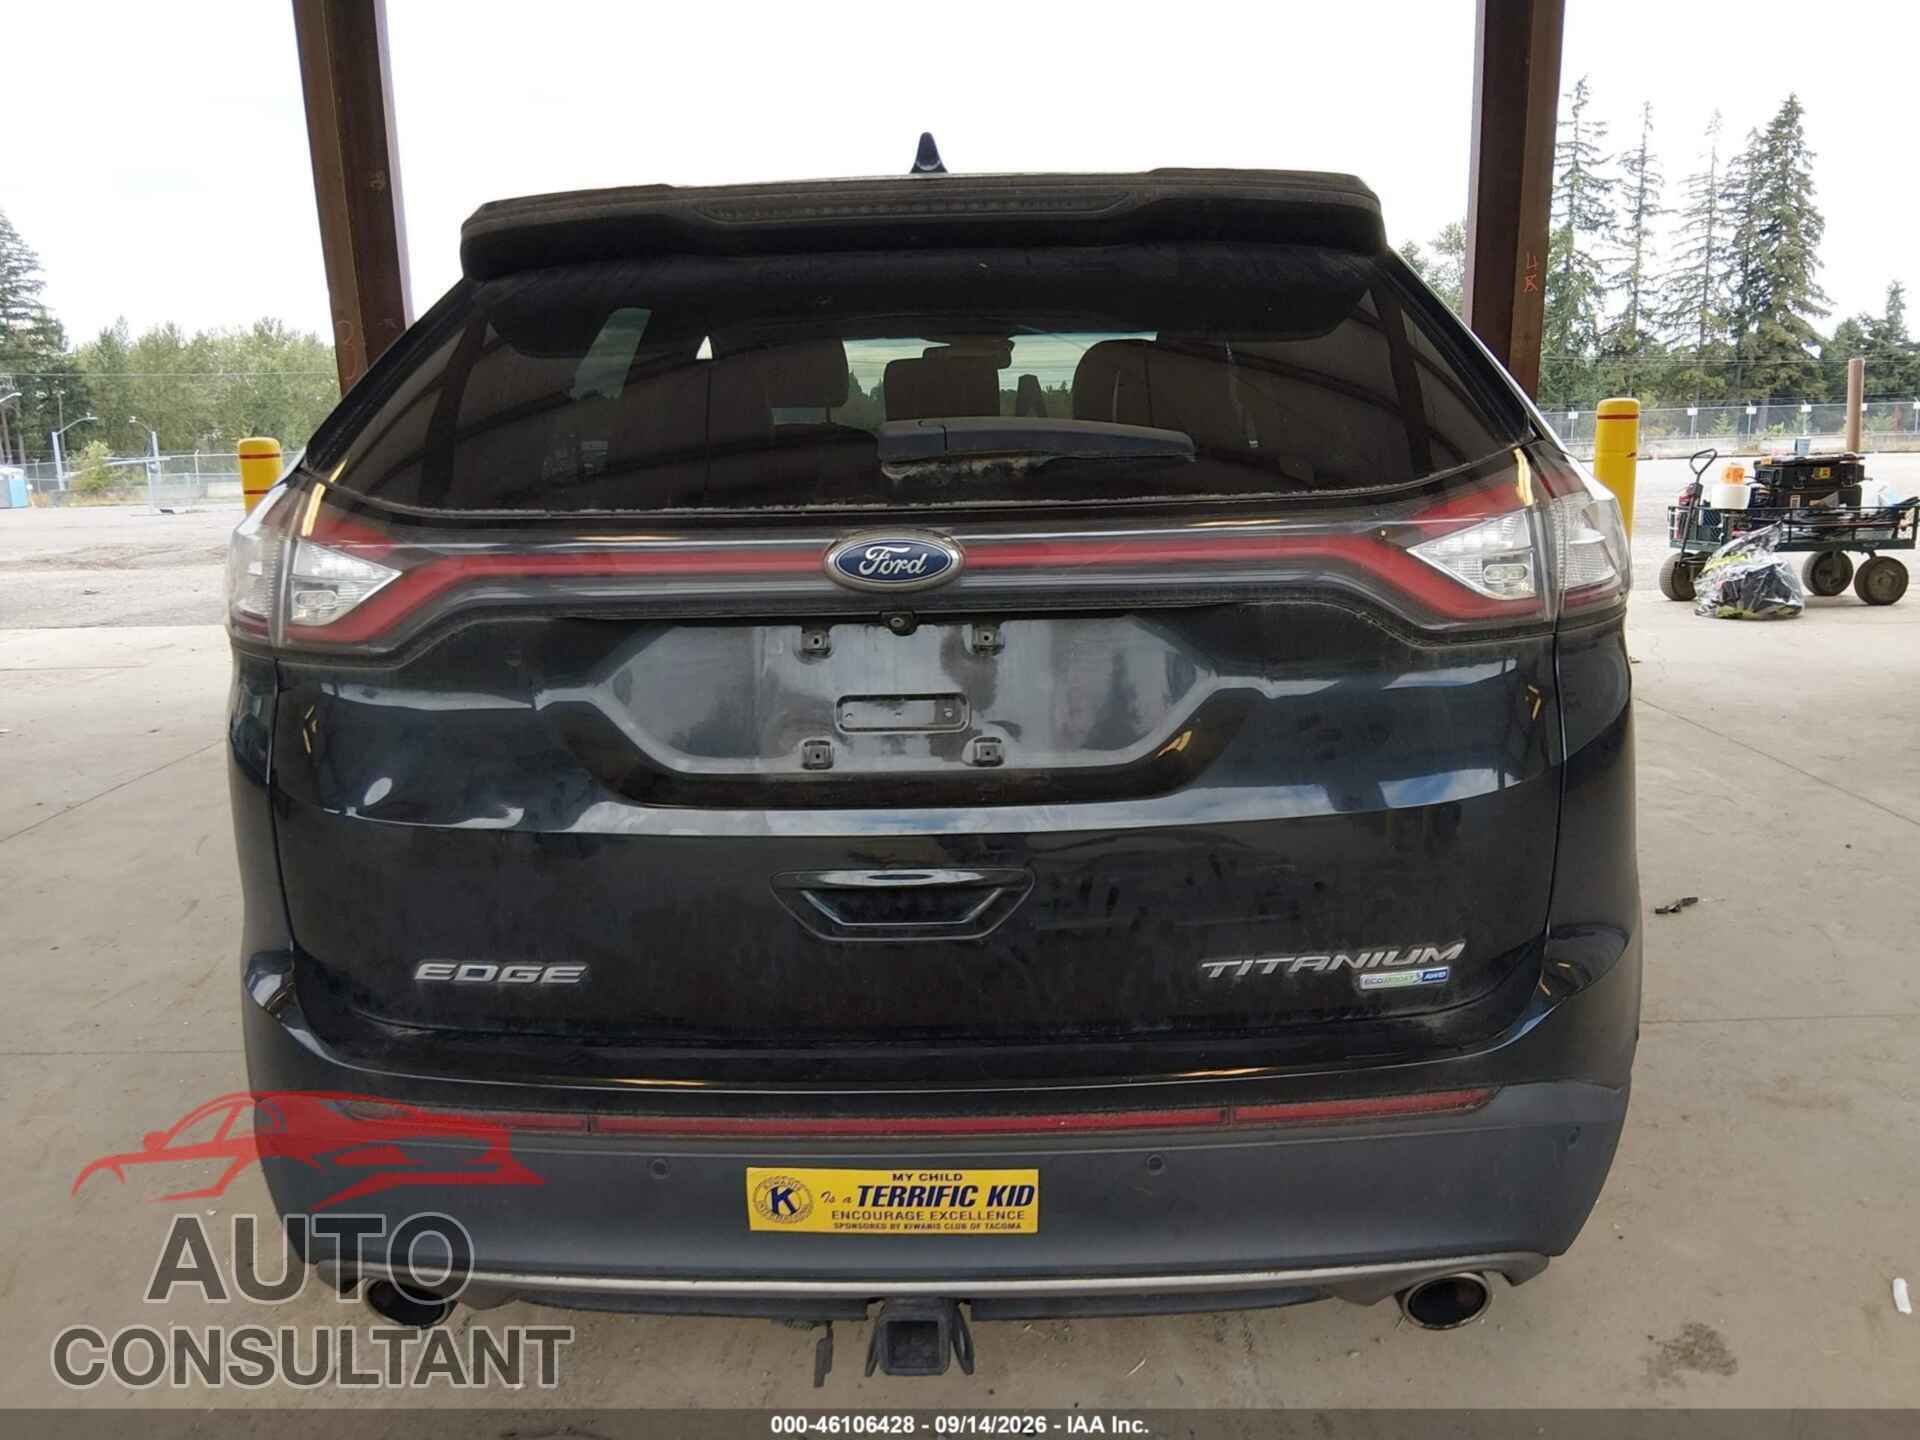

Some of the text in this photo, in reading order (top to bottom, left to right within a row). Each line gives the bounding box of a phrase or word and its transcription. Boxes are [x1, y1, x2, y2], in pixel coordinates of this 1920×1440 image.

[859, 546, 928, 575] Ford
[1201, 941, 1466, 978] TITANIUM
[415, 962, 587, 984] EDGE
[892, 1173, 963, 1181] MY CHILD
[770, 1186, 797, 1216] K
[857, 1185, 978, 1207] TERRIFIC
[986, 1185, 1035, 1207] KID
[831, 1210, 1025, 1220] ENCOURAGE EXCELLENCE
[984, 1222, 1022, 1230] TACOMA
